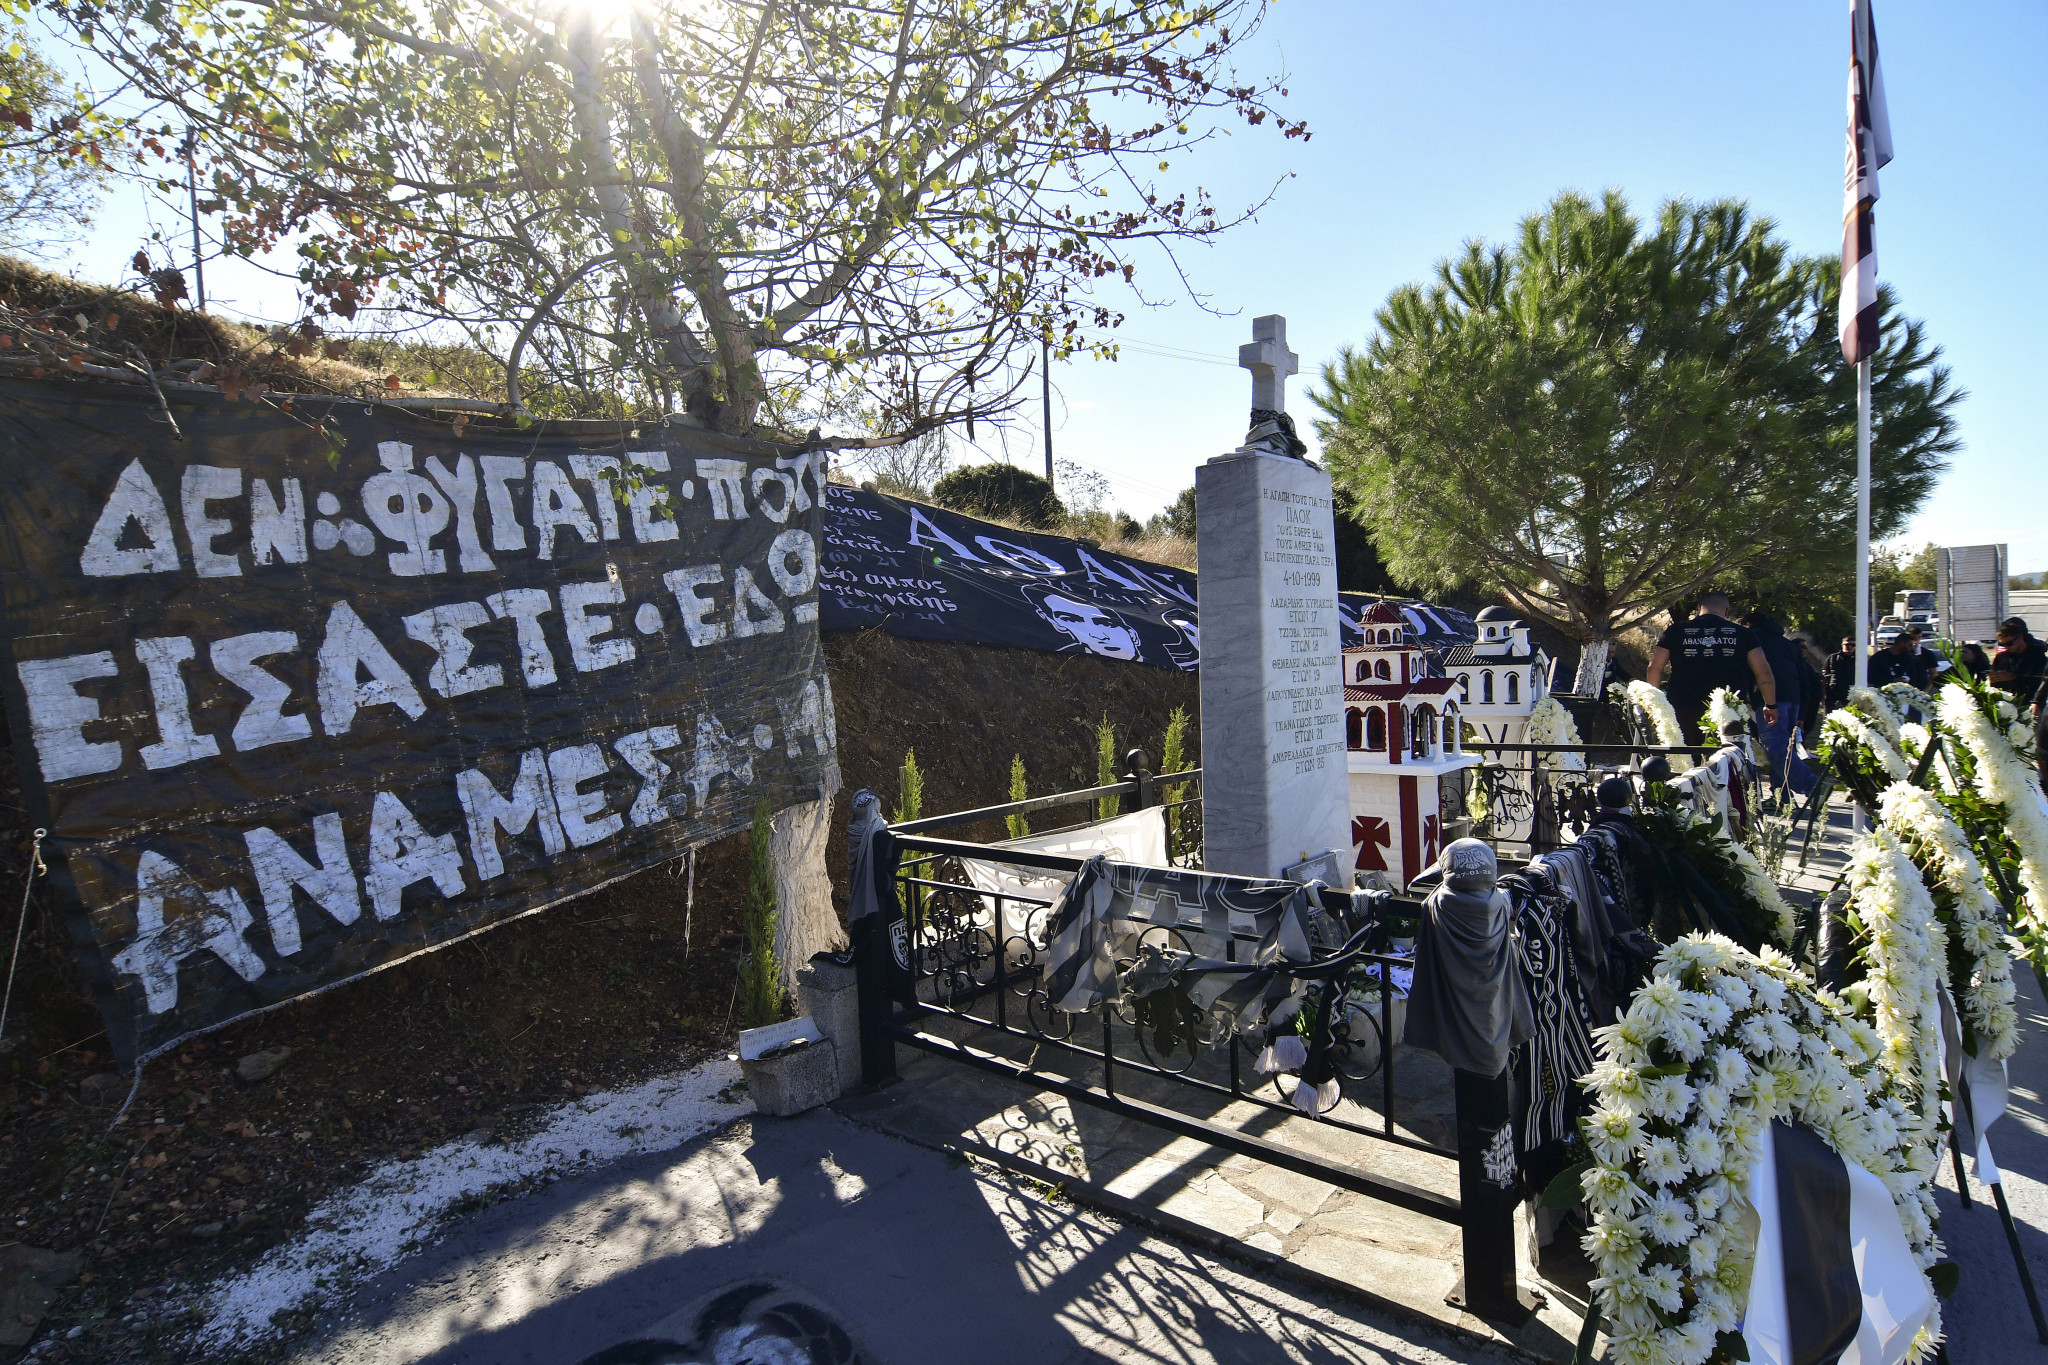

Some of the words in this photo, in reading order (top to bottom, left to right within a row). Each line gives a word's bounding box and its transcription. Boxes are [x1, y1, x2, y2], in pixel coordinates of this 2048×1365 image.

[80, 456, 309, 578] ΔΕΝ
[362, 441, 681, 576] ΦΥΓΑΤΕ
[1286, 507, 1312, 524] ΠΑΟΚ
[1284, 570, 1321, 587] 4-10-1999
[1311, 611, 1318, 622] 17
[17, 581, 637, 783] ΕΙΣΑΣΤΕ
[1296, 758, 1315, 775] ΕΤΩΝ
[1316, 757, 1325, 770] 25
[112, 712, 754, 1014] ΑΝΑΜΕΣΑ
[1528, 938, 1543, 978] 1926
